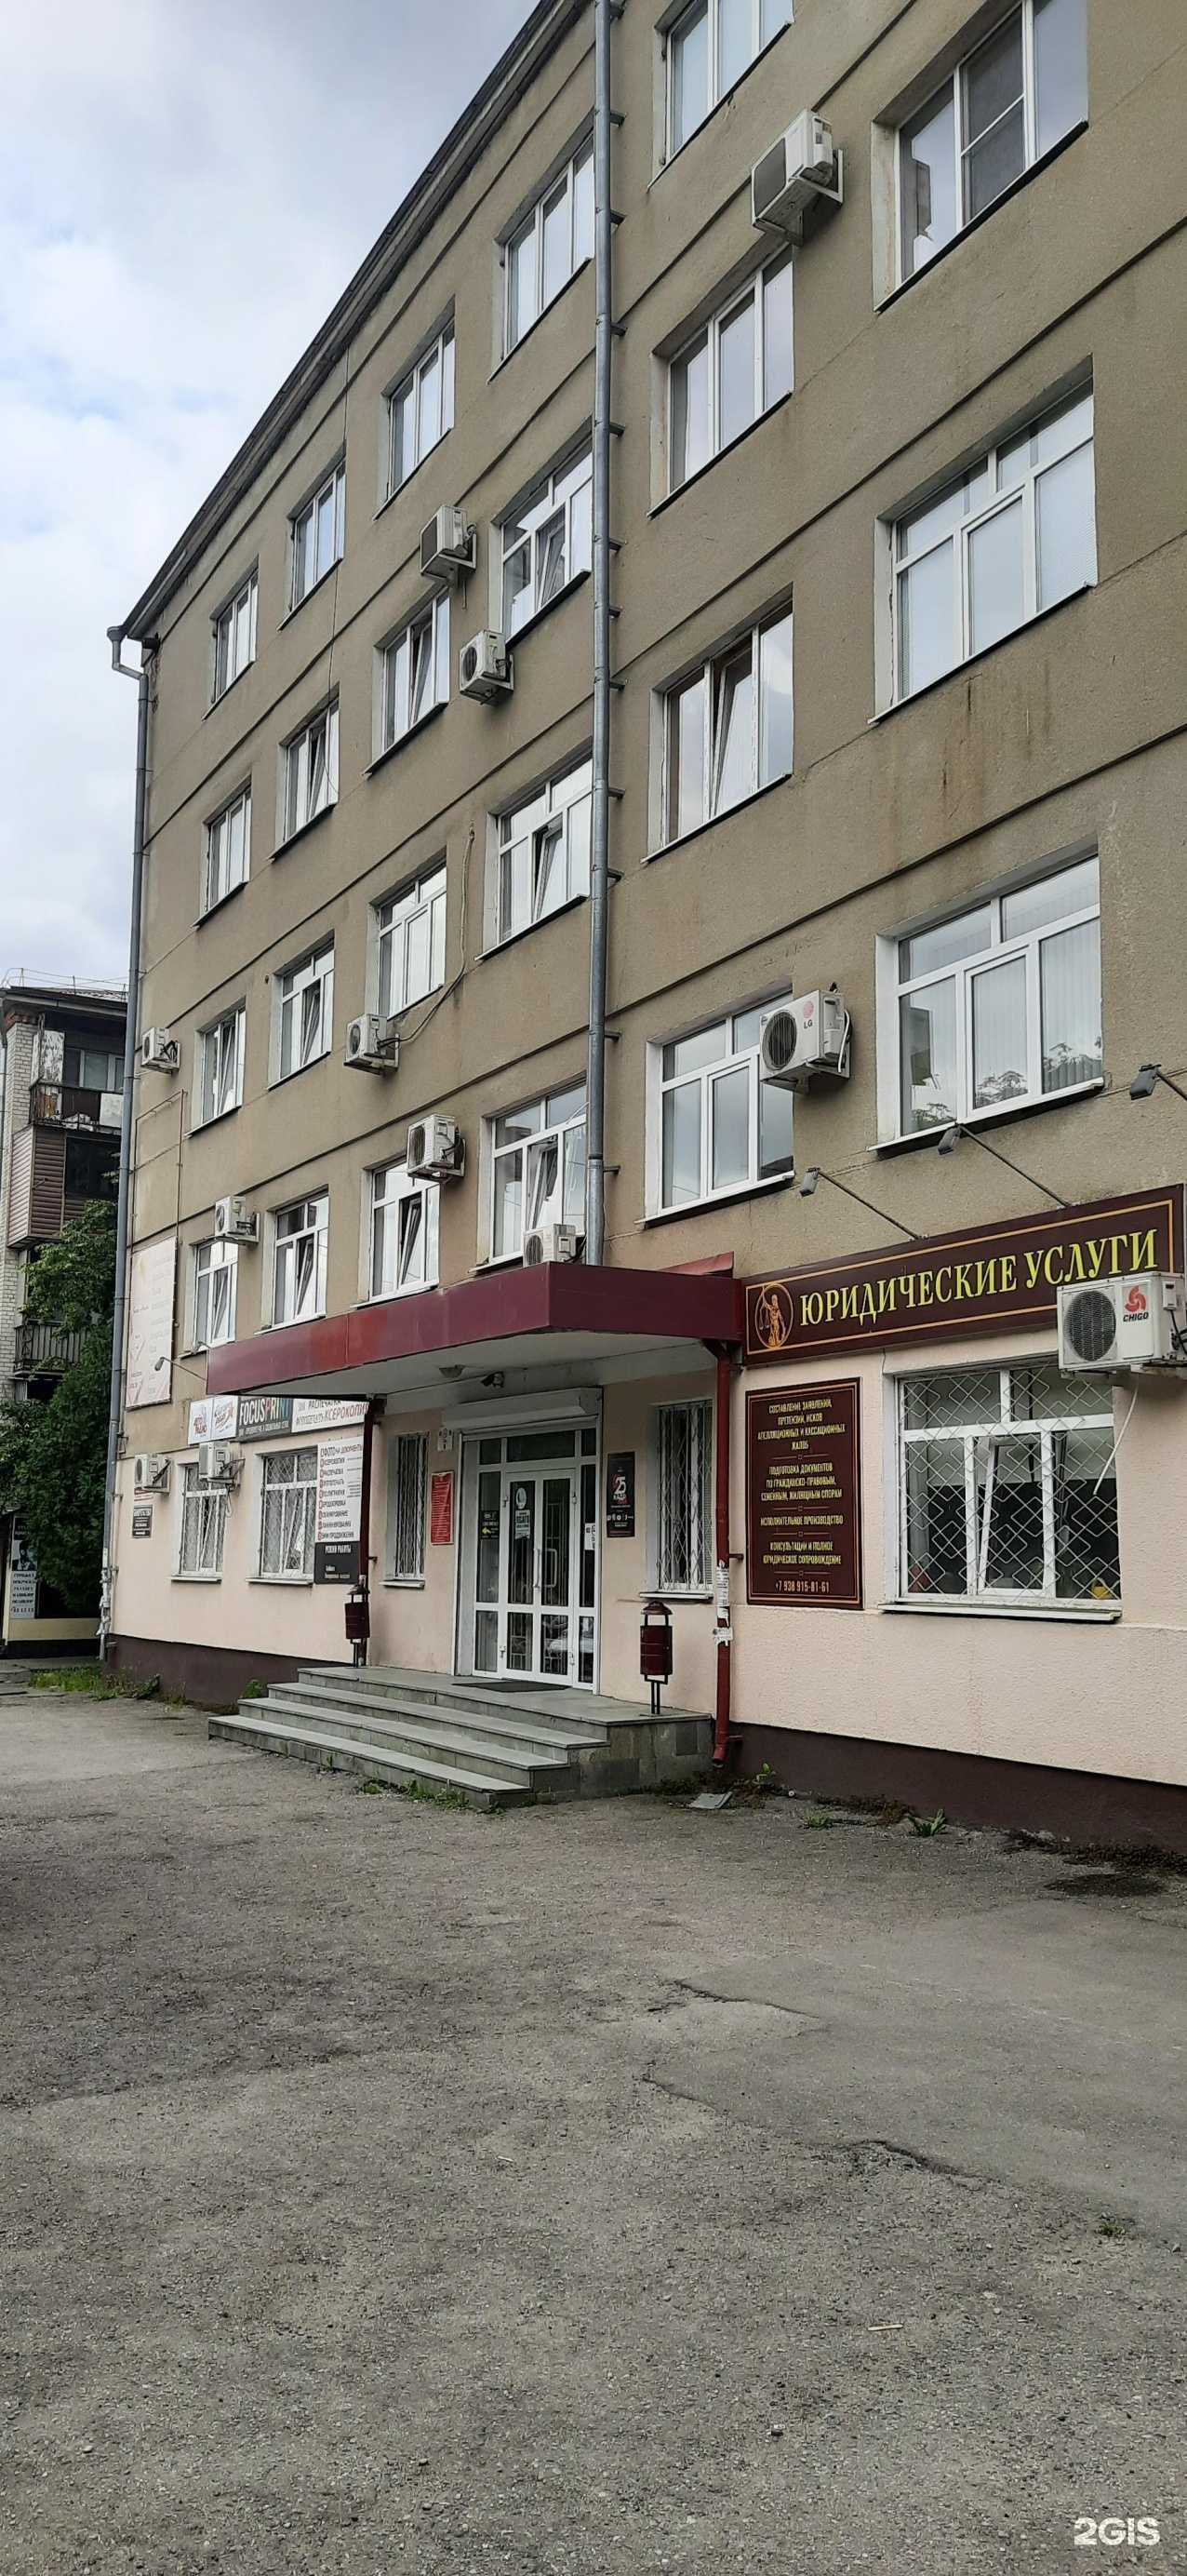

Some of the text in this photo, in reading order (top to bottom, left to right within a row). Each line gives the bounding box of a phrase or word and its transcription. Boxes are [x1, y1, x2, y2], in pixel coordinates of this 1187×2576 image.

[803, 1019, 813, 1029] LG
[799, 1228, 1158, 1327] ЮРИДИЧЕСКИЕ УСЛУГИ
[1123, 1311, 1149, 1322] CHIGO
[768, 1462, 834, 1475] ПОДГОТОВКА ДОКУМЕНТОВ
[614, 1476, 627, 1495] 25
[820, 1489, 843, 1499] СПОРАМ
[804, 1515, 844, 1526] ПРОИЗВОДСТВО
[812, 1541, 834, 1551] ПОЛНОЕ
